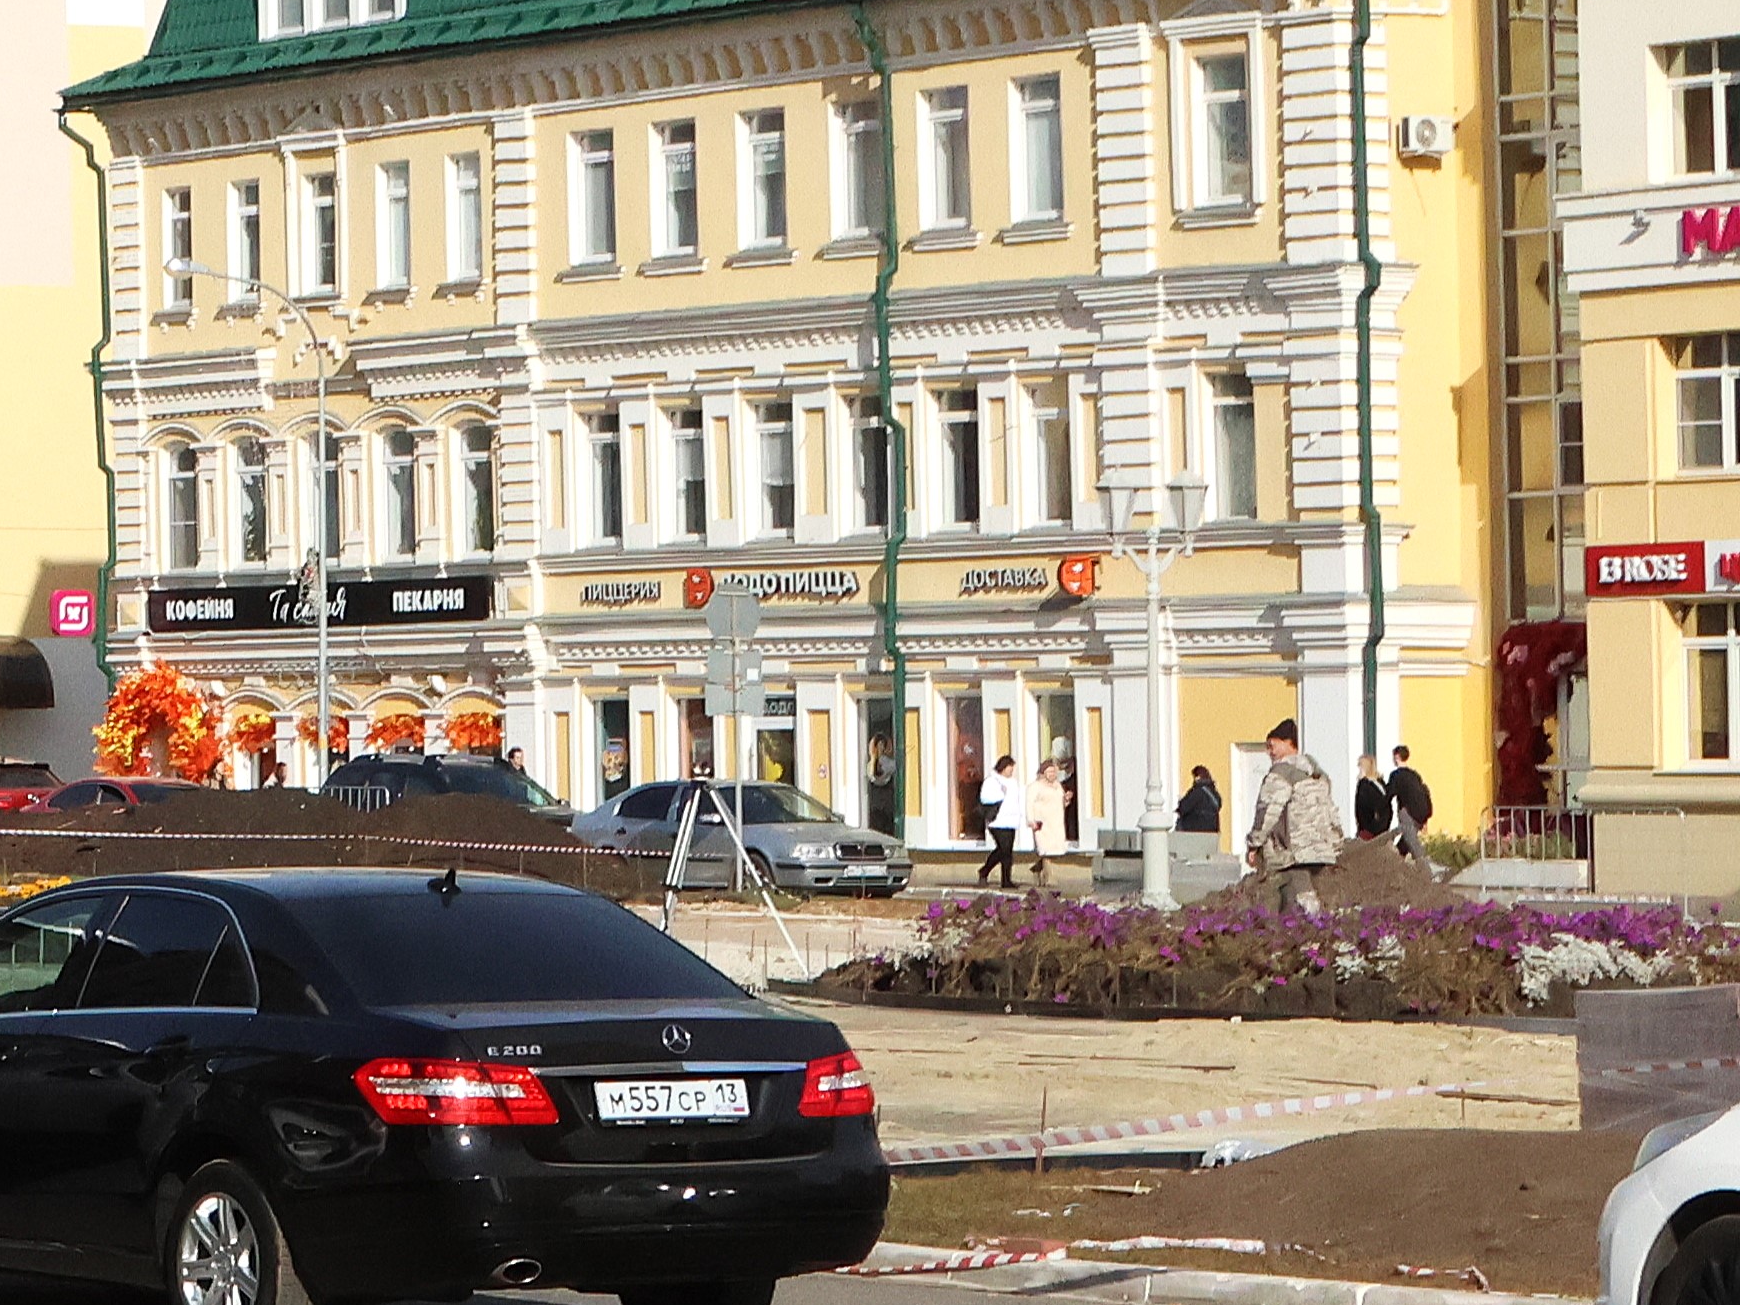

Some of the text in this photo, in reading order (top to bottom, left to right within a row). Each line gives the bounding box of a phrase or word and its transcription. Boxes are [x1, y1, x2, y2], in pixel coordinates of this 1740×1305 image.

[779, 570, 858, 597] ПИЦЦА
[962, 566, 1048, 591] ДОСТАВКА
[392, 588, 465, 612] ПЕКАРНЯ
[581, 580, 661, 603] ПИЦЦЕРИЯ
[166, 595, 234, 621] КОФЕЙНЯ
[609, 1083, 737, 1113] М557СР 13
